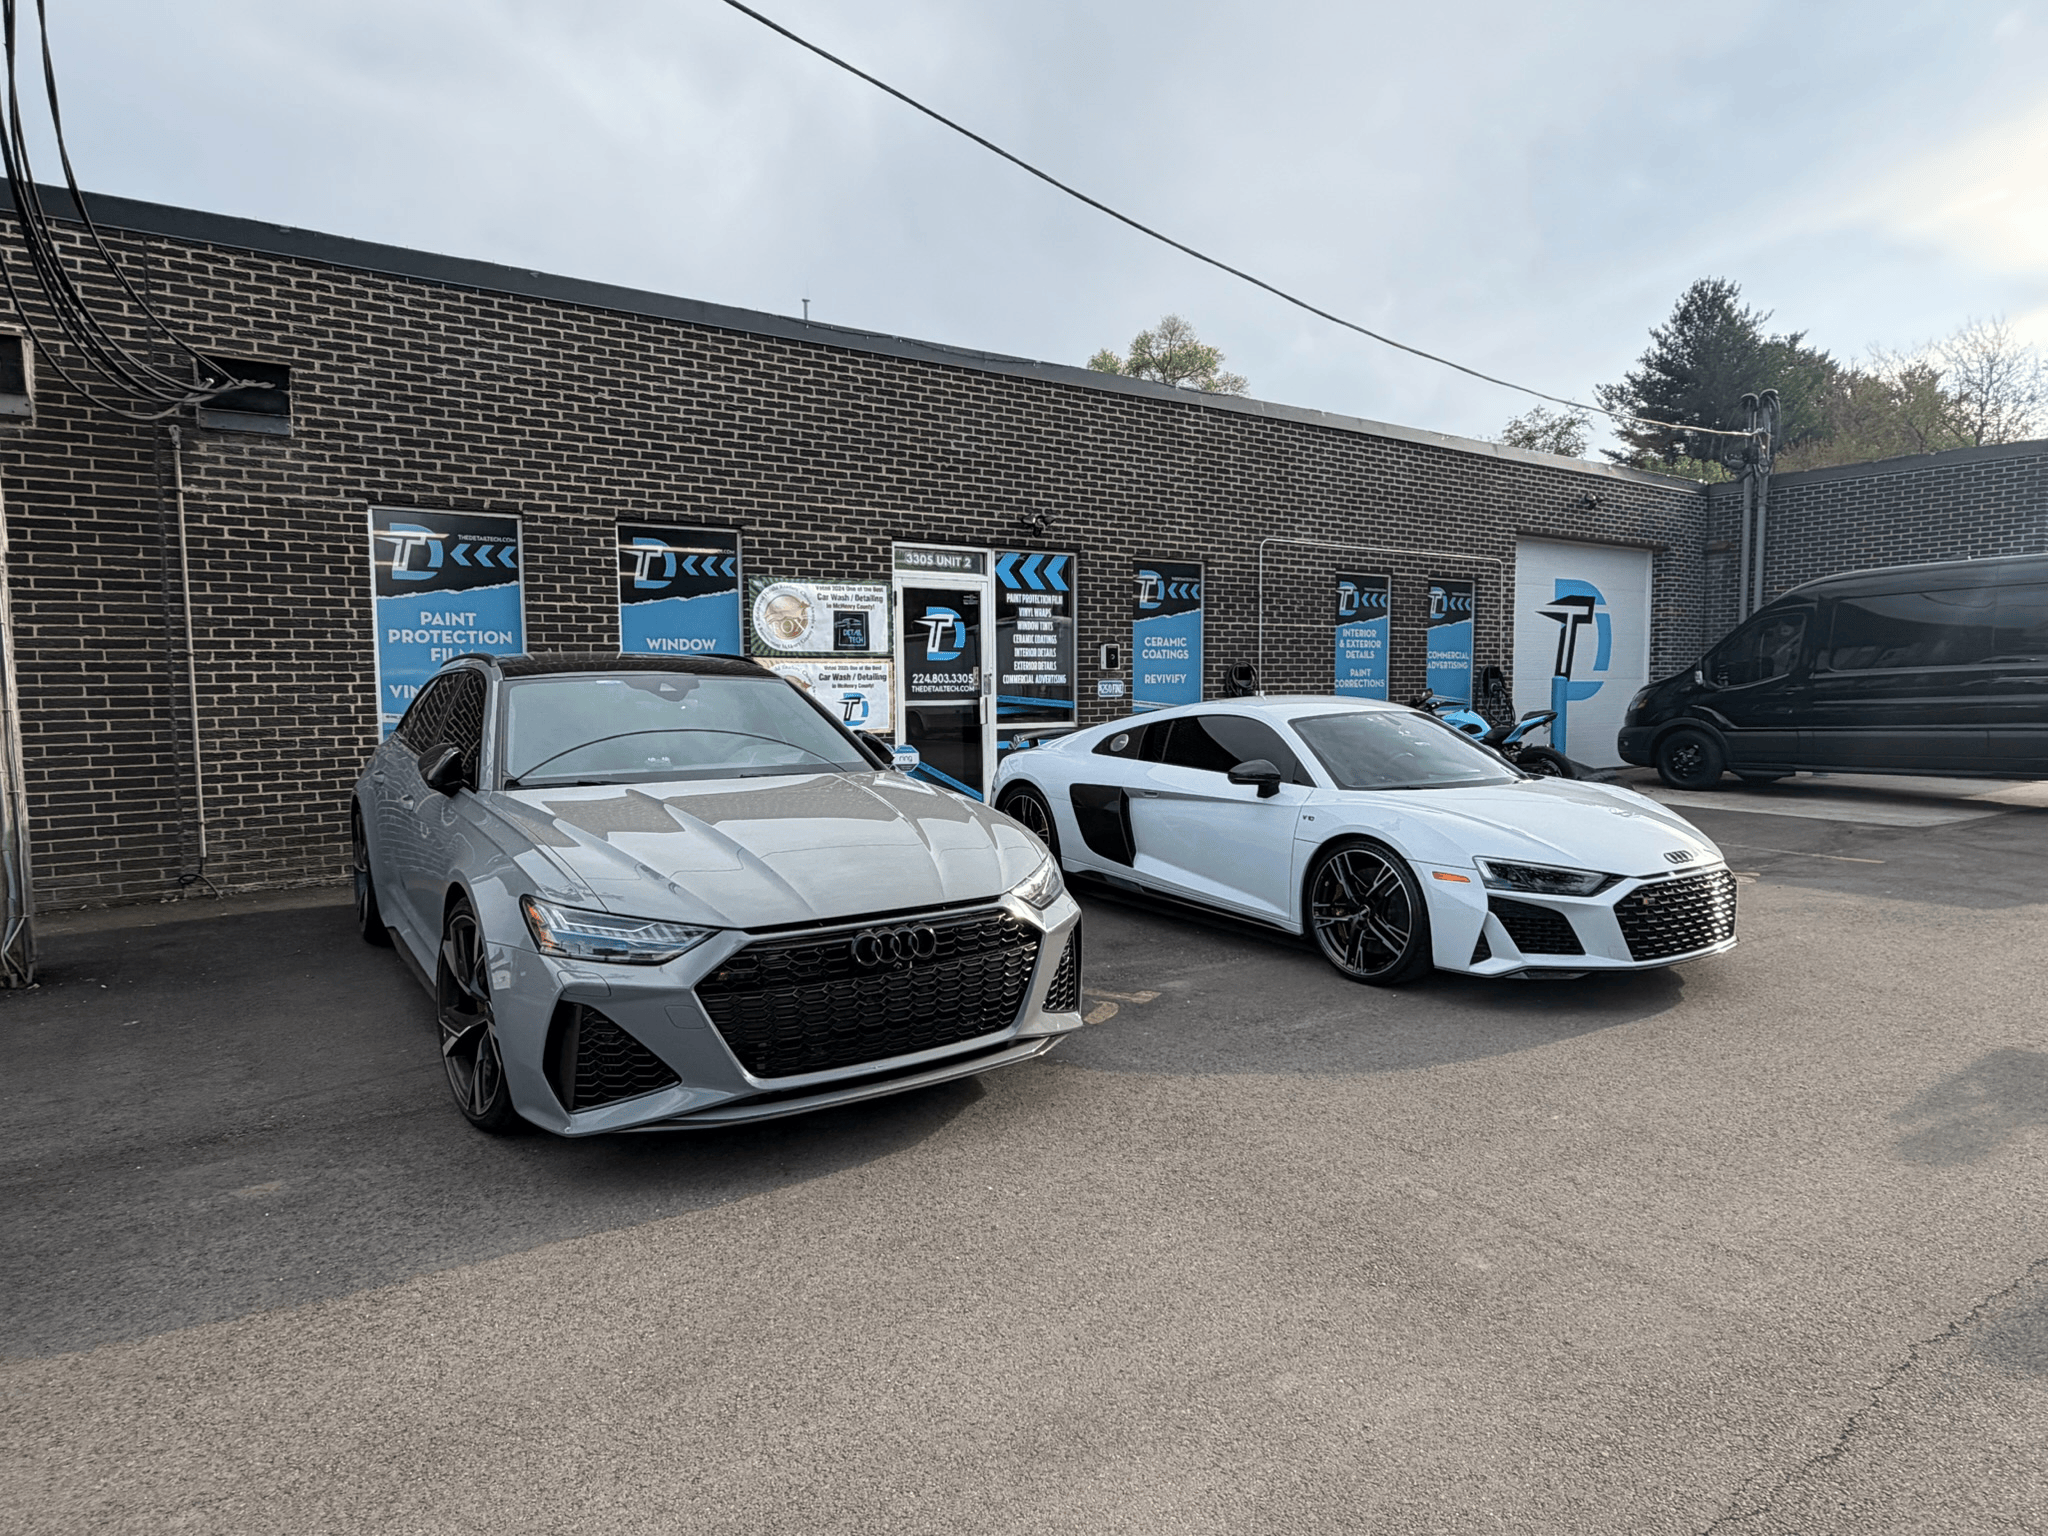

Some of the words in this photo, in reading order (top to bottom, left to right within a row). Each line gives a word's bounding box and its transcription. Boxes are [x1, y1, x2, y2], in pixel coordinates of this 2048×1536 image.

[457, 534, 517, 543] THEDETAILTECH.COM
[906, 553, 933, 565] 3305
[936, 555, 962, 567] UNIT
[964, 557, 971, 568] 2
[817, 593, 829, 601] Car
[830, 593, 850, 601] Wash
[855, 594, 883, 604] Detailing
[1006, 593, 1021, 603] PAINT
[1022, 593, 1052, 604] PROTECTION
[1052, 595, 1063, 605] FILM
[1019, 607, 1033, 617] VINYL
[1034, 607, 1052, 618] WRAPS
[420, 611, 477, 626] PAINT
[1017, 621, 1039, 631] WINDOW
[1040, 621, 1053, 631] TINTS
[388, 629, 513, 645] PROTECTION
[1342, 628, 1377, 638] INTERIOR
[646, 637, 716, 651] WINDOW
[1013, 634, 1034, 644] CERAMIC
[1035, 634, 1057, 644] COATINGS
[1144, 637, 1187, 647] CERAMIC
[1339, 639, 1345, 648] &
[1346, 639, 1382, 649] EXTERIOR
[1014, 648, 1037, 657] INTERIOR
[1037, 648, 1056, 658] DETAILS
[1142, 649, 1189, 660] COATINGS
[1345, 650, 1375, 659] DETAILS
[1427, 651, 1469, 660] COMMERCIAL
[1014, 661, 1038, 671] EXTERIOR
[1038, 661, 1057, 671] DETAILS
[1427, 660, 1468, 669] ADVERTISING
[819, 672, 831, 681] Car
[832, 672, 851, 681] Wash
[857, 673, 887, 682] Detailing
[1350, 668, 1371, 677] PAINT
[912, 673, 974, 685] 224.803.3305
[1003, 674, 1034, 684] COMMERCIAL
[1035, 674, 1067, 684] ADVERTISING
[1144, 673, 1187, 684] REVIVIFY
[1334, 679, 1385, 688] CORRECTIONS
[389, 685, 423, 699] VIN
[911, 685, 975, 693] THEDETAILTECH.COM
